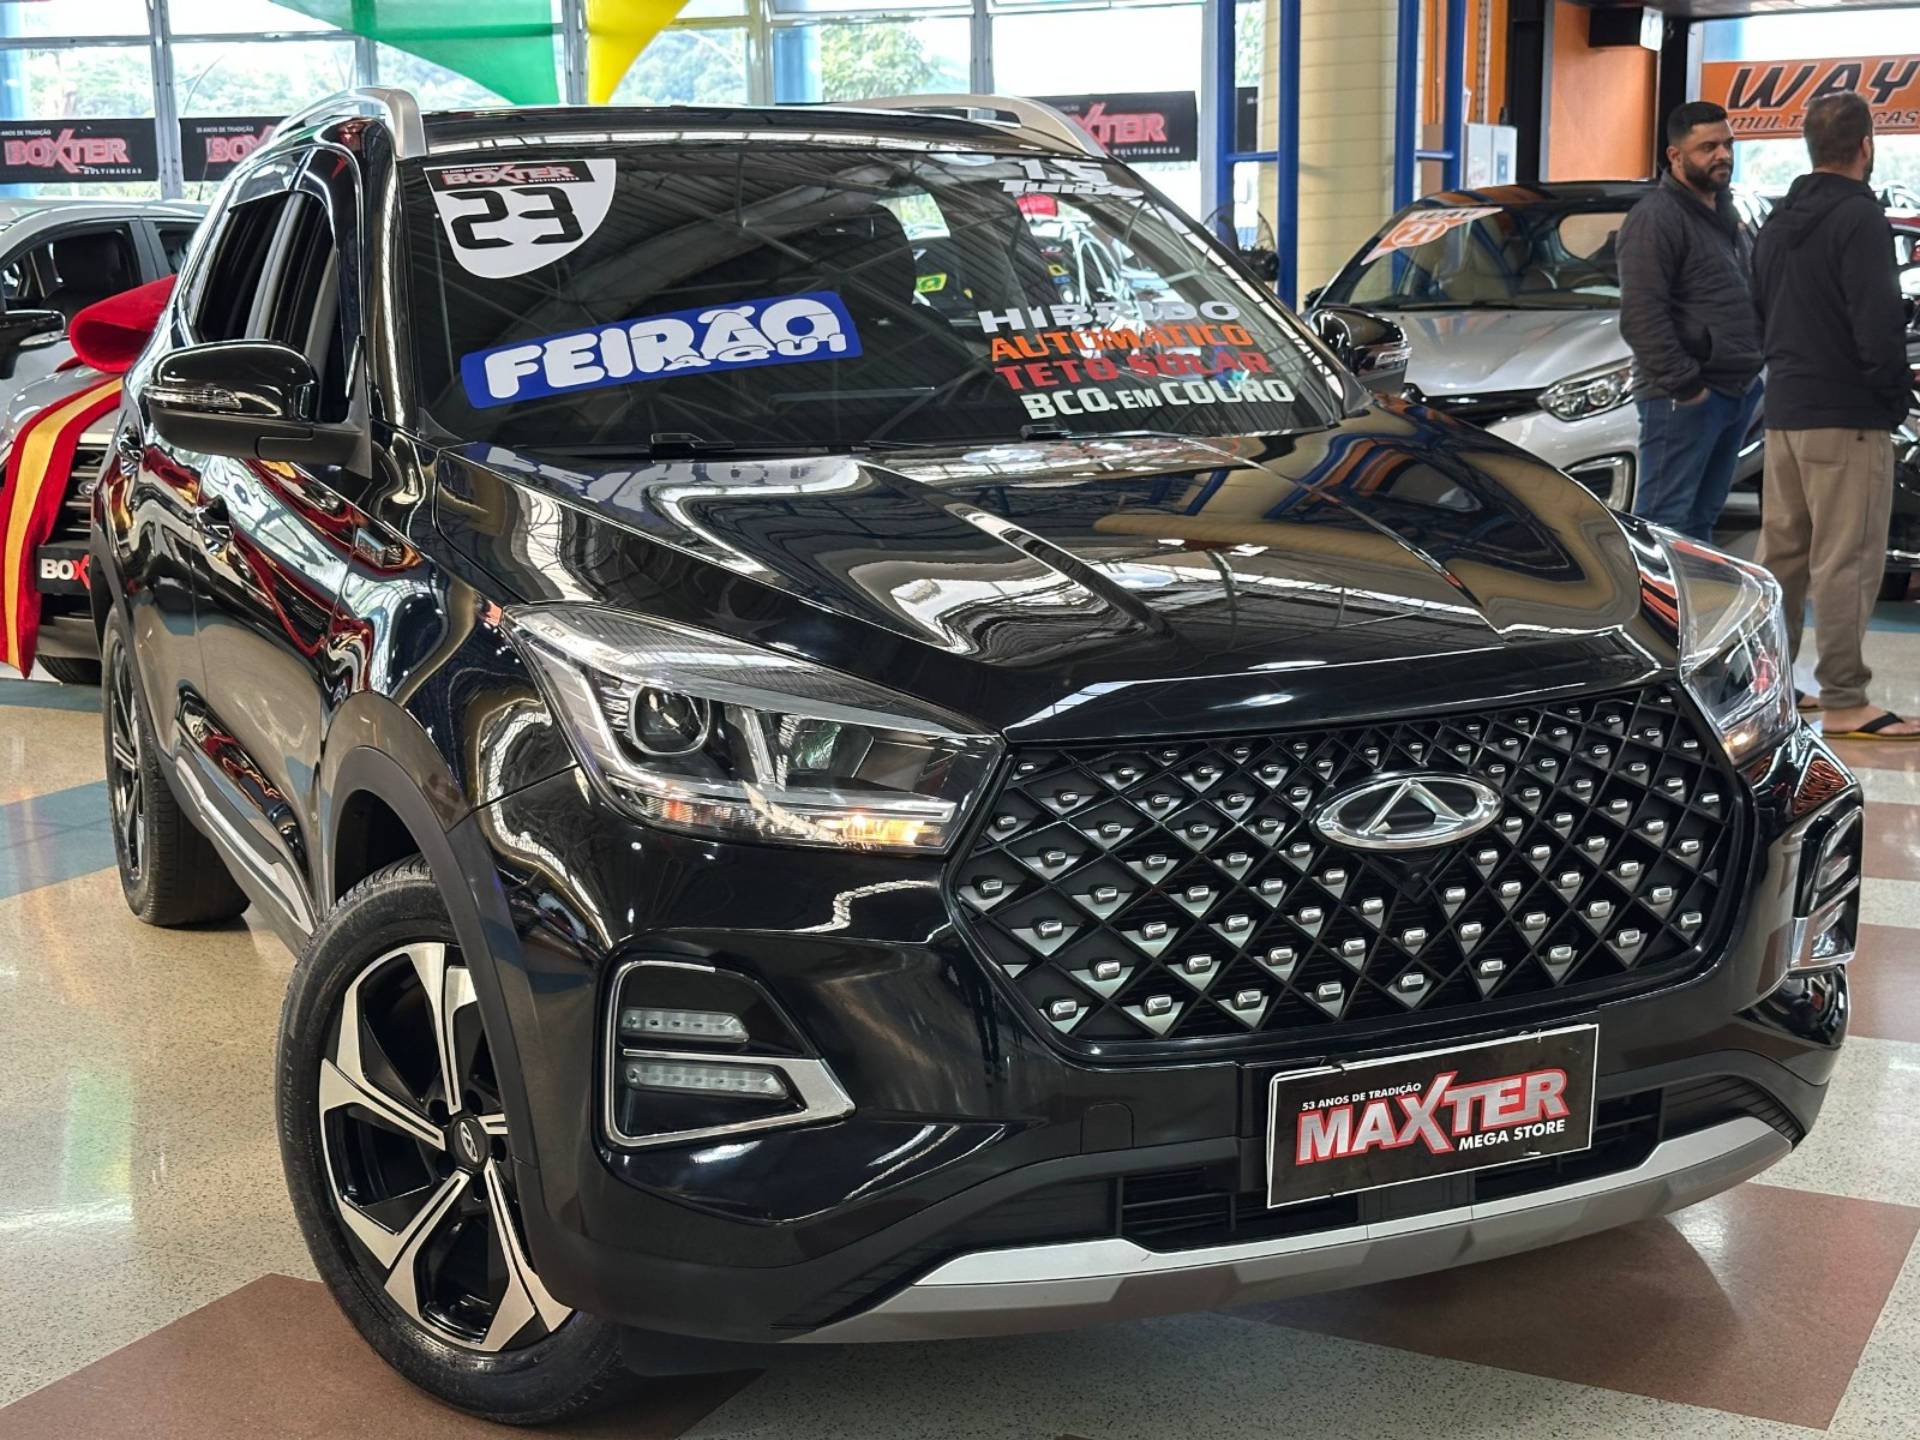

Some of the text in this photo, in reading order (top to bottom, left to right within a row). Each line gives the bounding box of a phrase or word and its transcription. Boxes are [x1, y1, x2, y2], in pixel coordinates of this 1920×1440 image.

[4, 128, 131, 174] BOXTER
[440, 164, 575, 186] BOXTER
[447, 186, 584, 250] 23
[484, 298, 841, 399] FEIRÃO
[994, 351, 1273, 390] TETO SOLAR
[1158, 379, 1296, 405] COURO
[1302, 1082, 1422, 1111] 53 ANOS DE TRADIÇÃO
[1296, 1070, 1570, 1165] MAXTER
[1458, 1119, 1566, 1151] MEGA STORE
